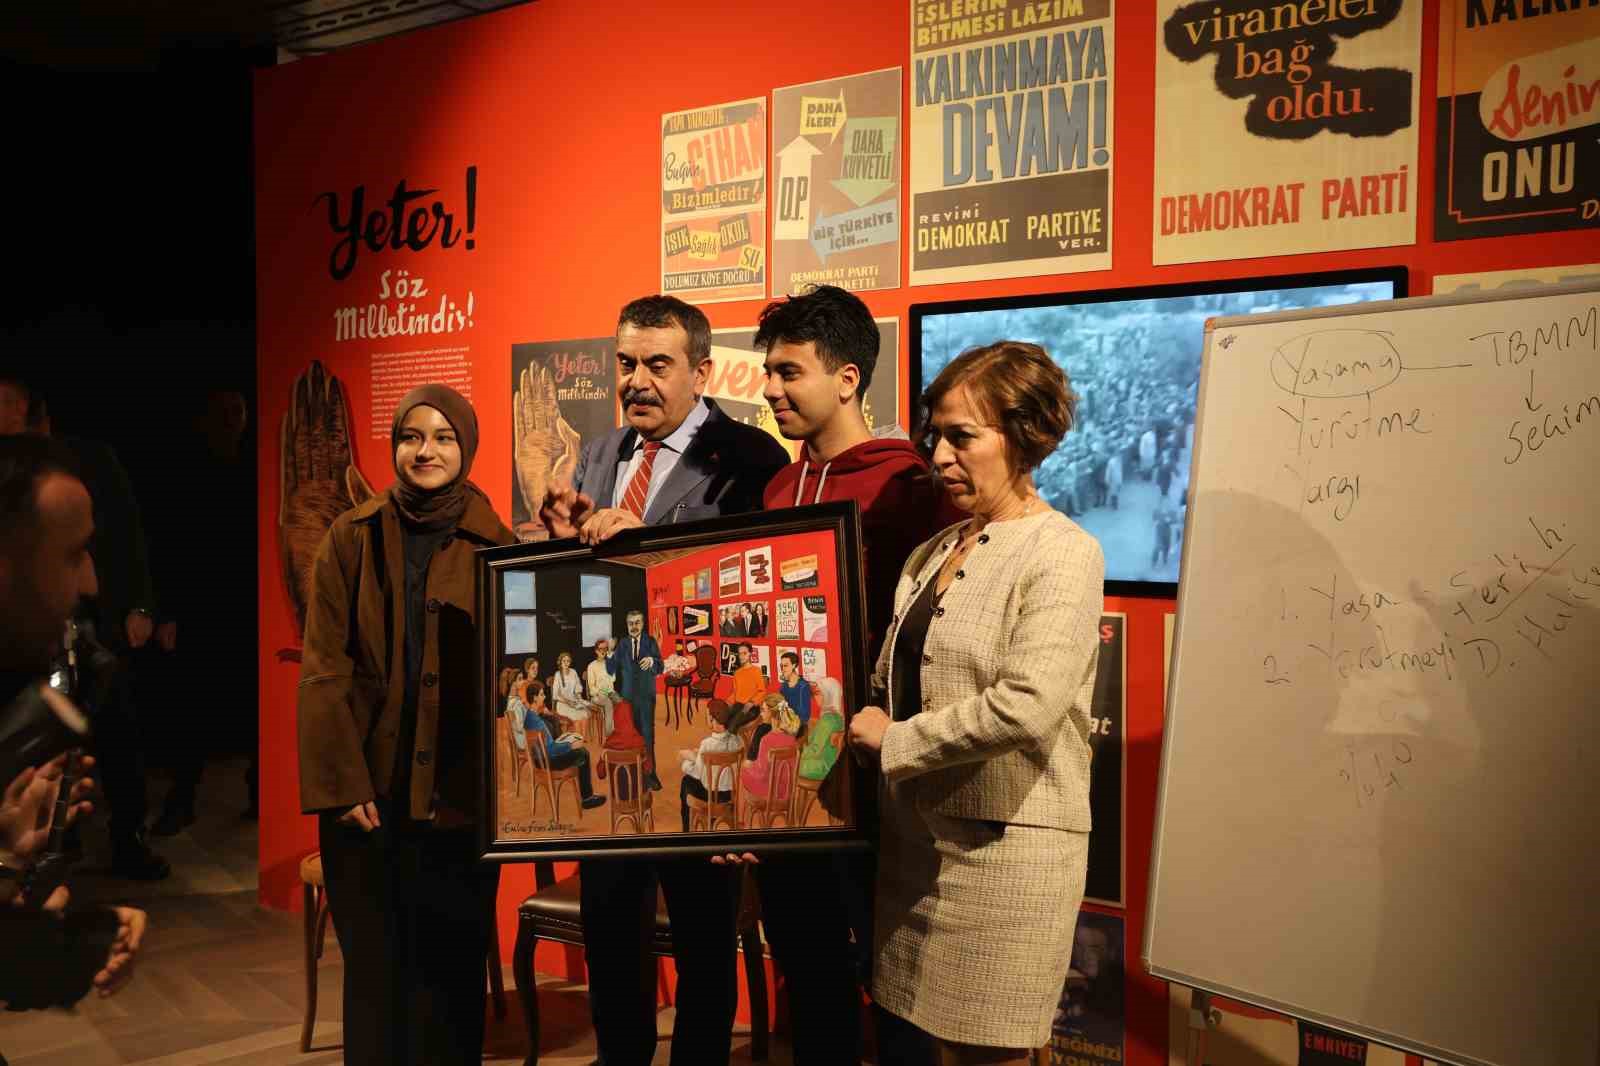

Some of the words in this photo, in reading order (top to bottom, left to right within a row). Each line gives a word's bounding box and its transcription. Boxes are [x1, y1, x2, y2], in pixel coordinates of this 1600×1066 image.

[915, 26, 1107, 107] KALKINMAYA
[1233, 39, 1314, 83] bağ
[807, 103, 842, 114] DAHA
[1266, 80, 1374, 122] oldu.
[852, 129, 883, 154] DAHA
[943, 79, 1110, 187] DEVAM!
[1482, 142, 1576, 202] ONU
[919, 203, 980, 224] REYİNİ
[1160, 183, 1305, 237] DEMOKRAT
[1322, 165, 1409, 220] PARTİ
[918, 218, 1010, 252] DEMOKRAT
[1026, 208, 1102, 241] PARTİYE
[1058, 238, 1101, 250] VER.
[379, 270, 428, 299] Söz
